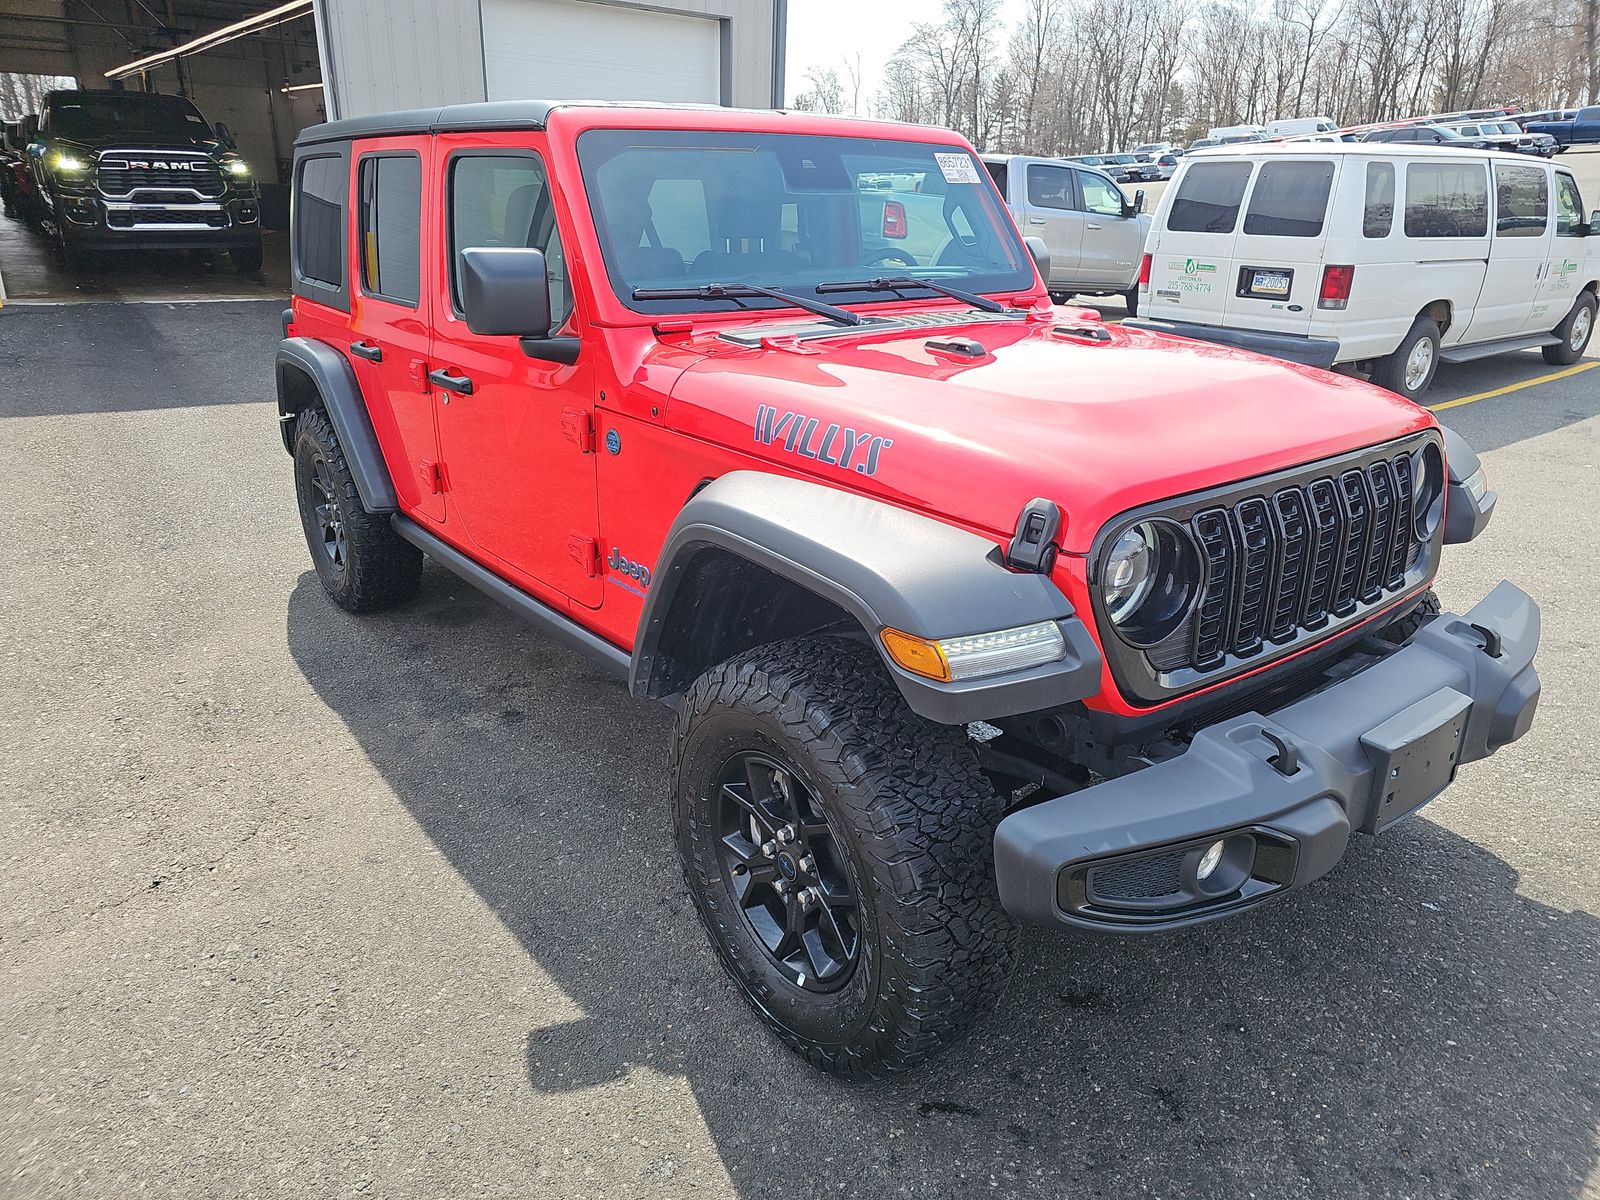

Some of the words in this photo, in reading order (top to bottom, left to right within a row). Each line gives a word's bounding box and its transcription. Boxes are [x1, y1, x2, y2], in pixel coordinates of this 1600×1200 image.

[129, 161, 189, 171] RAM
[937, 156, 974, 168] 8657231
[754, 404, 893, 476] WILLYS
[607, 546, 651, 588] Jeep
